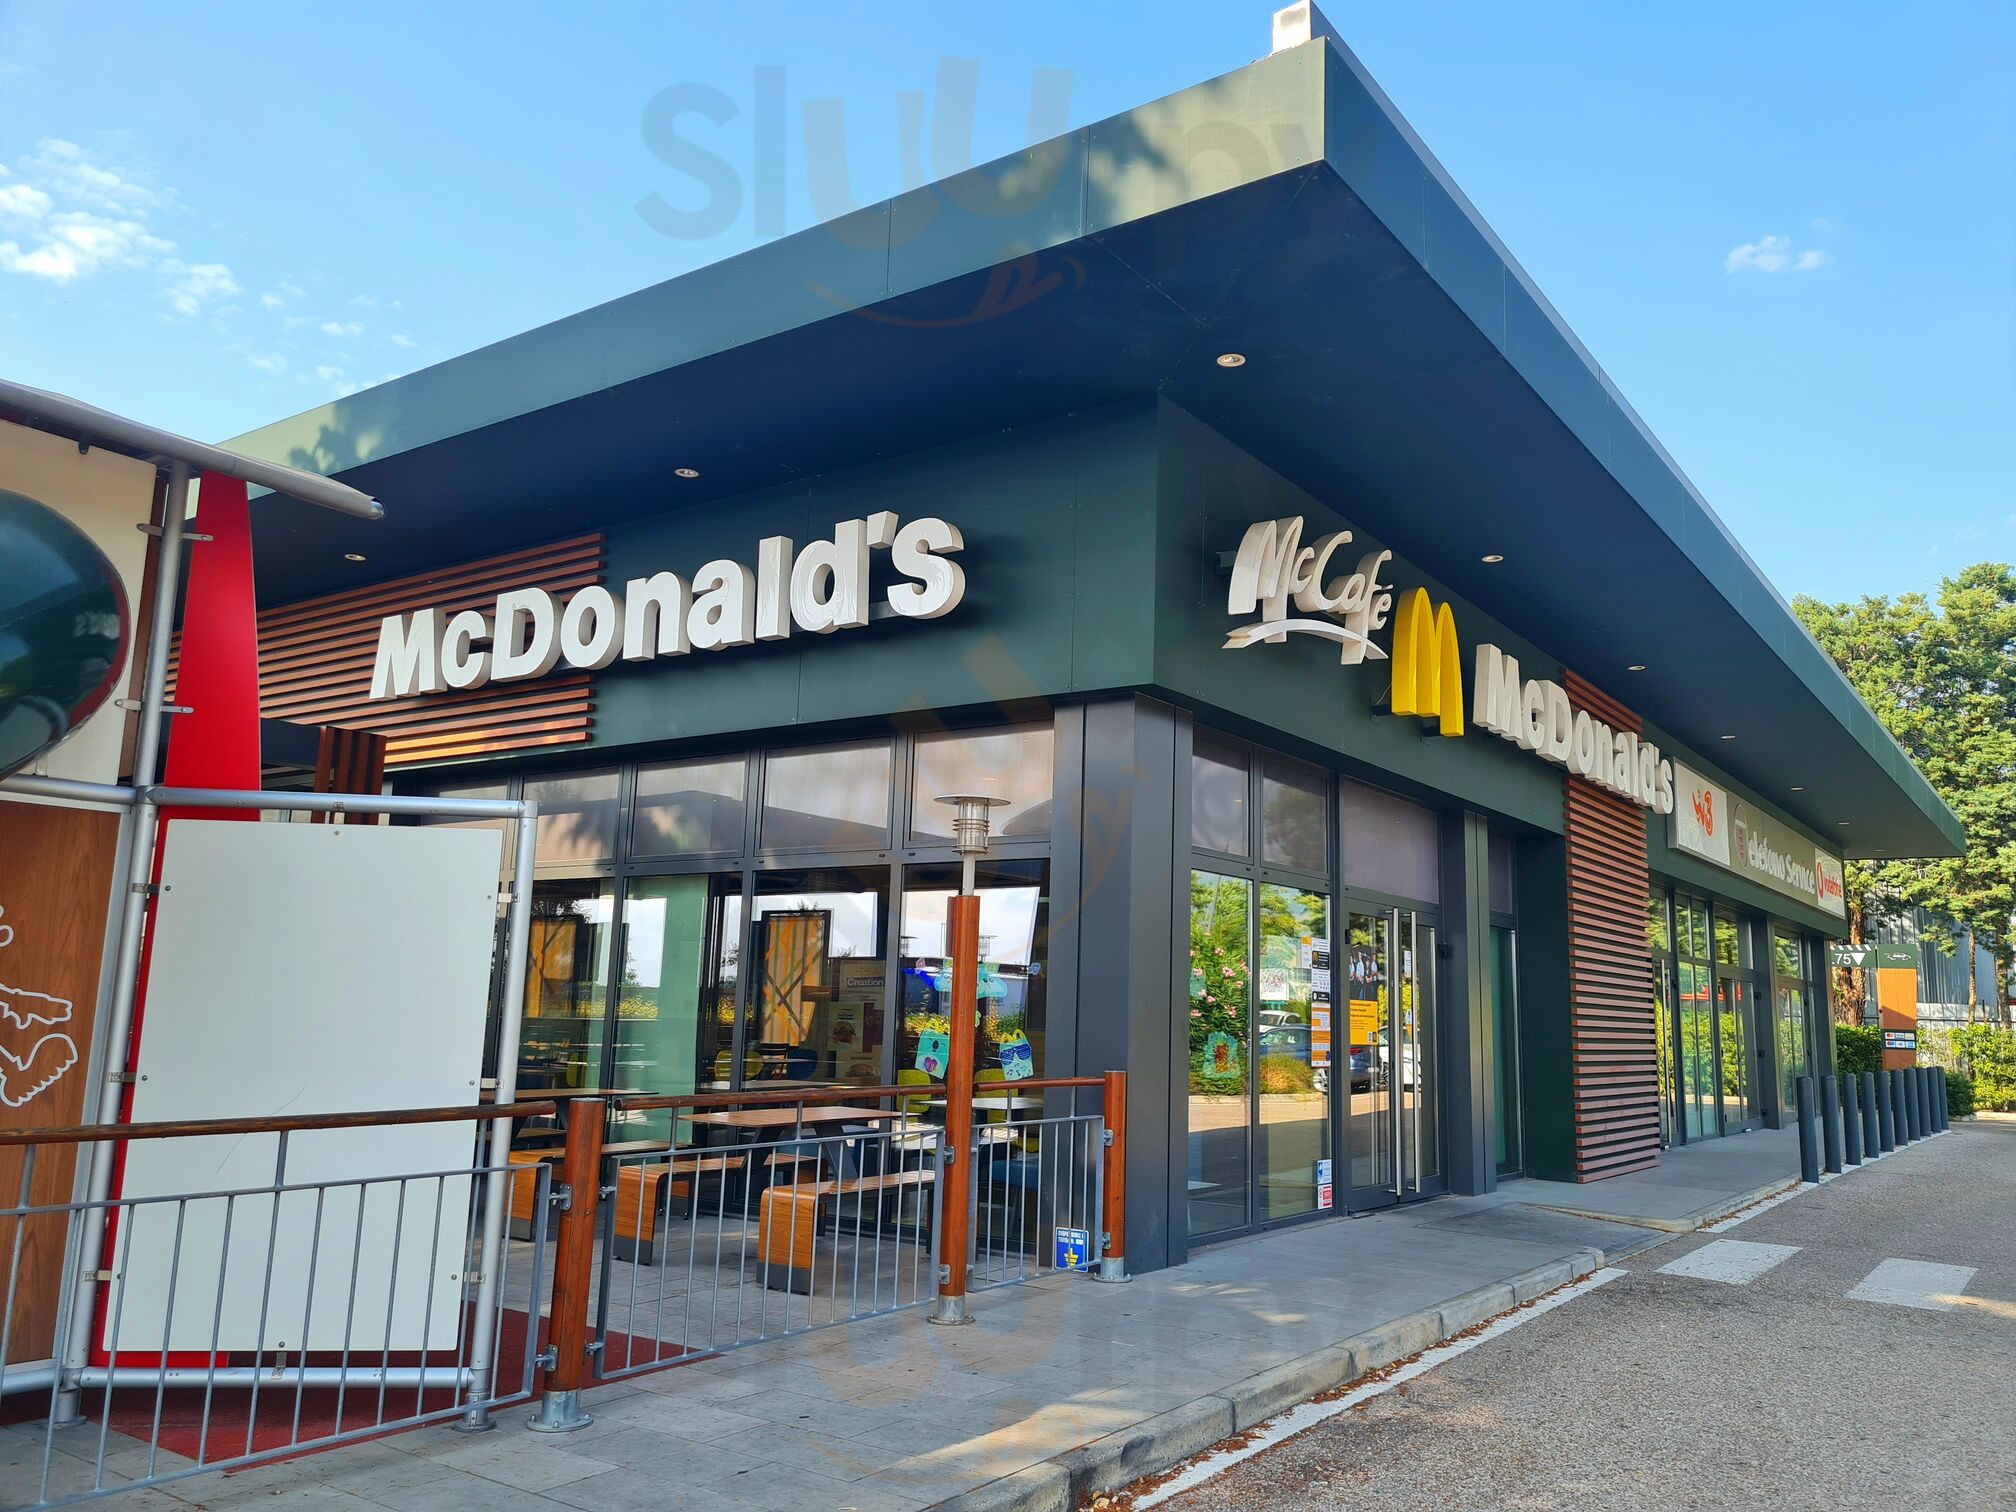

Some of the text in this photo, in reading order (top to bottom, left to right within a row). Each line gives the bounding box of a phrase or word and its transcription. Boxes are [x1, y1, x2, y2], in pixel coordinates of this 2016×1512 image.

[369, 510, 966, 699] McDonald's
[1227, 515, 1394, 665] McCafé
[1472, 643, 1675, 815] McDonald's
